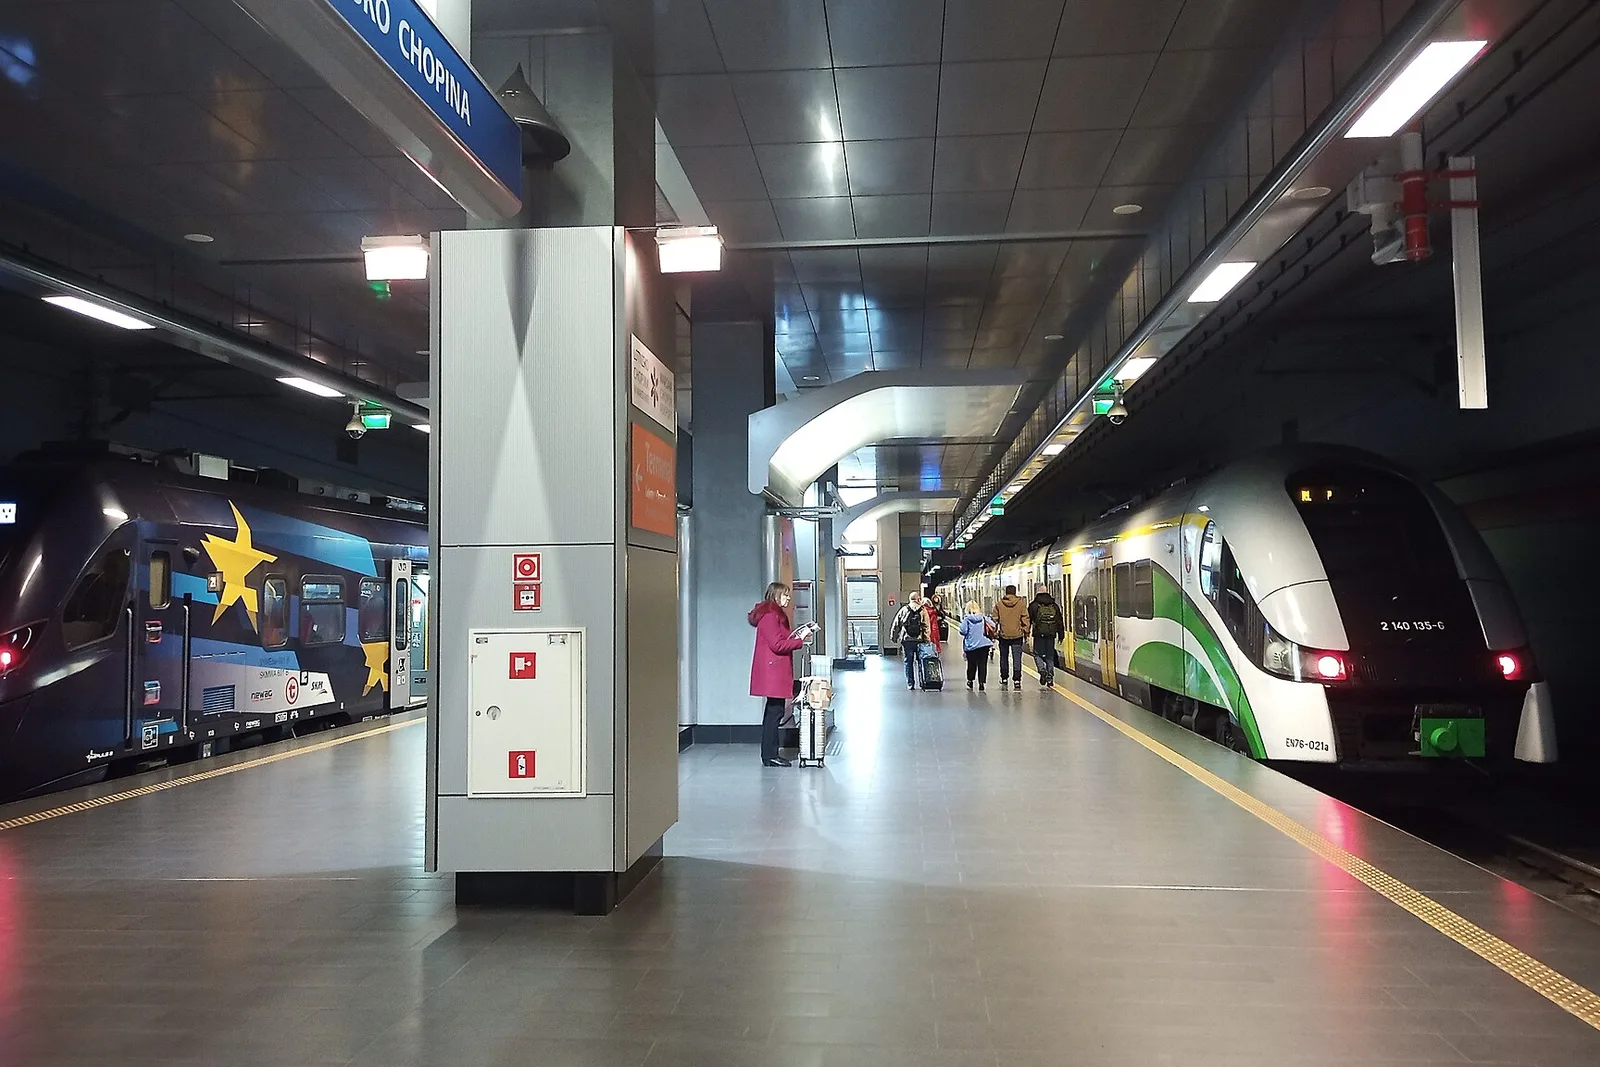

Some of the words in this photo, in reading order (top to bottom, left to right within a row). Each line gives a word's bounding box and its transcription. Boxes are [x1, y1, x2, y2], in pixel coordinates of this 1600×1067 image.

[398, 19, 471, 127] CHOPINA
[1380, 621, 1390, 631] 2
[1391, 621, 1411, 631] 140
[1412, 621, 1446, 631] 135-6
[1285, 737, 1329, 751] EN76-021a
